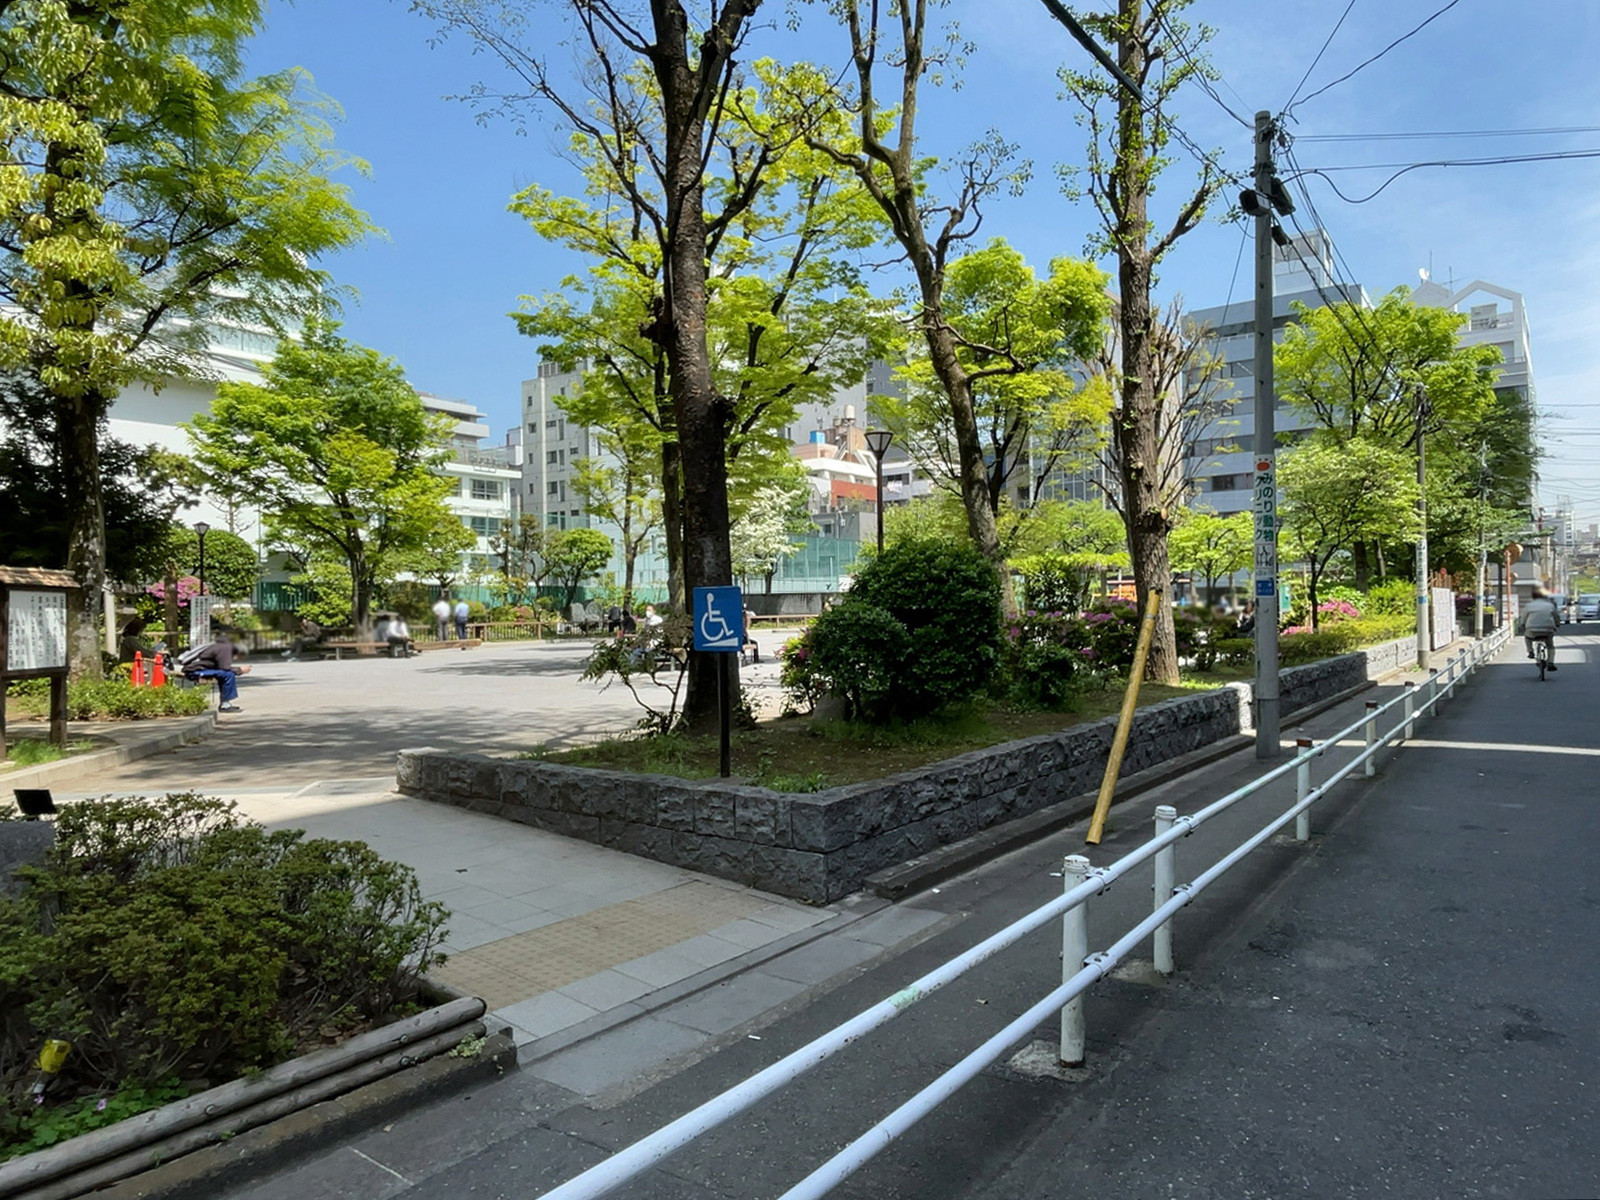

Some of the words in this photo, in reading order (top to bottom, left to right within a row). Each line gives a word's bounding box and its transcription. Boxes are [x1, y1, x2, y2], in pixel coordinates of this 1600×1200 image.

[1255, 475, 1263, 540] クリニック
[1263, 472, 1274, 542] みのり動物
